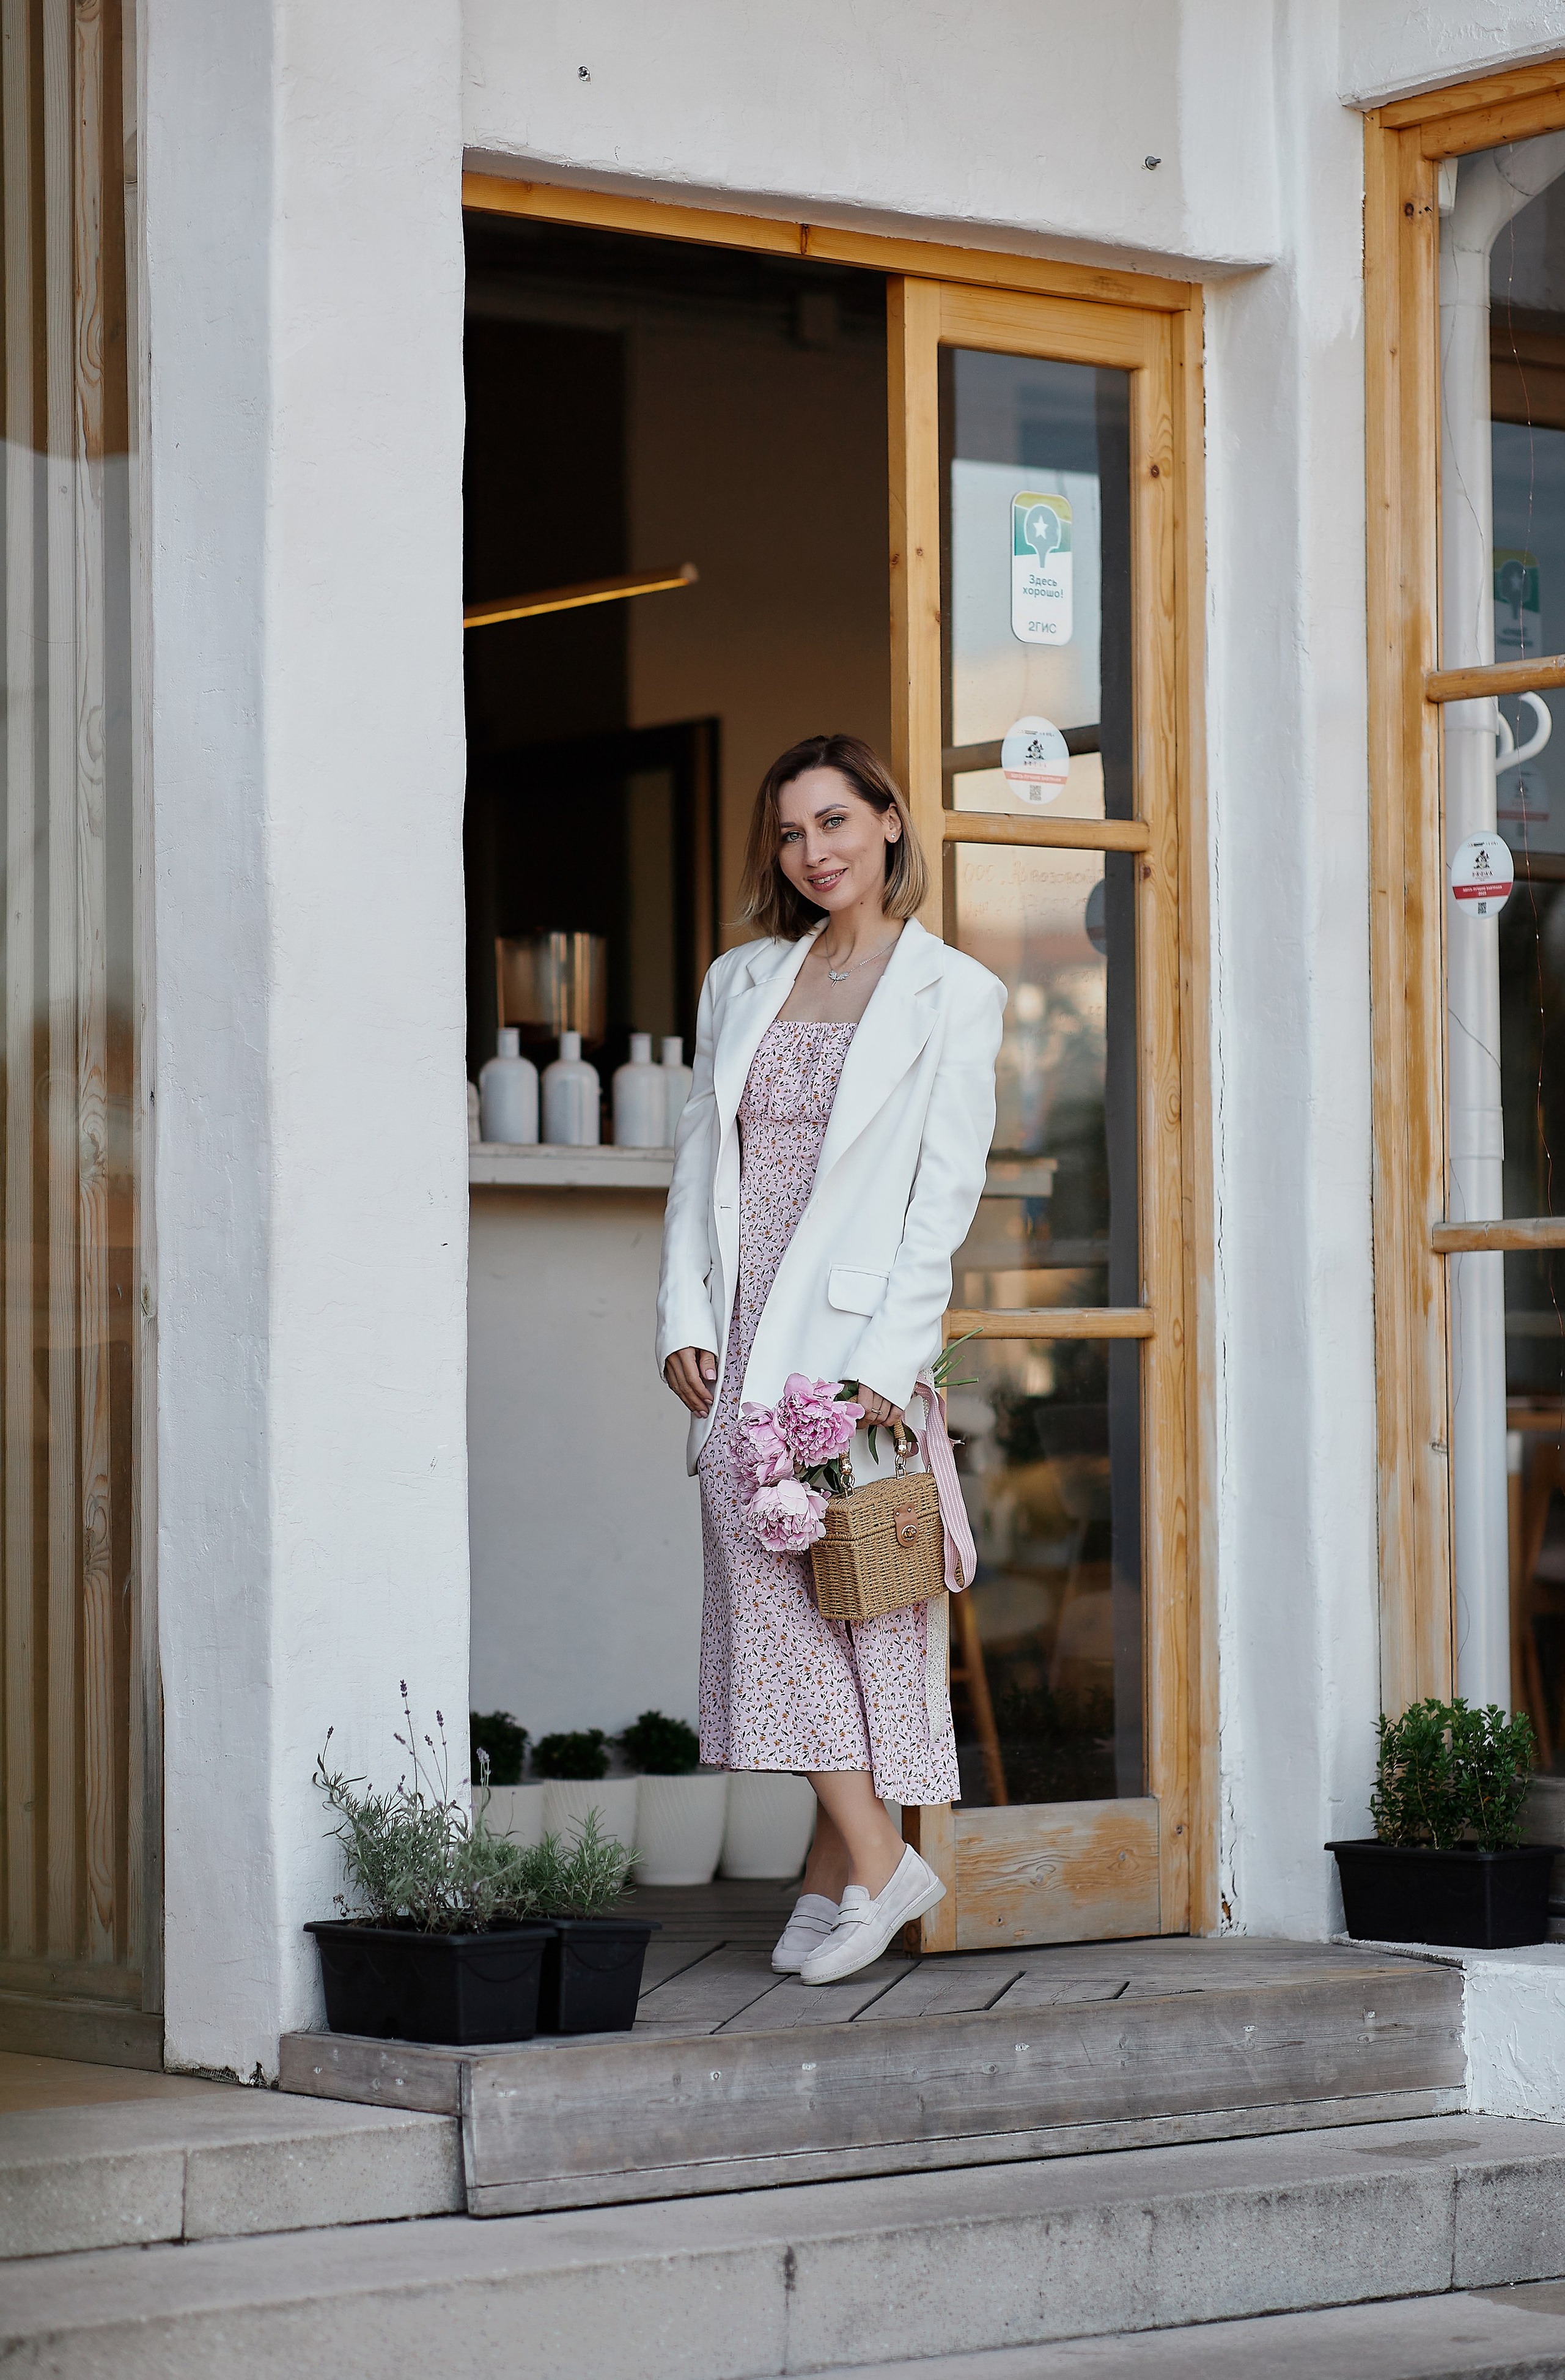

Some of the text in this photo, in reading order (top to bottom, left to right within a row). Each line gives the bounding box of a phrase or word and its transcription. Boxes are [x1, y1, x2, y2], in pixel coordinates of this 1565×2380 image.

[1029, 574, 1058, 586] Здесь
[1023, 587, 1063, 598] хорошо!
[1028, 621, 1057, 634] 2ГИС
